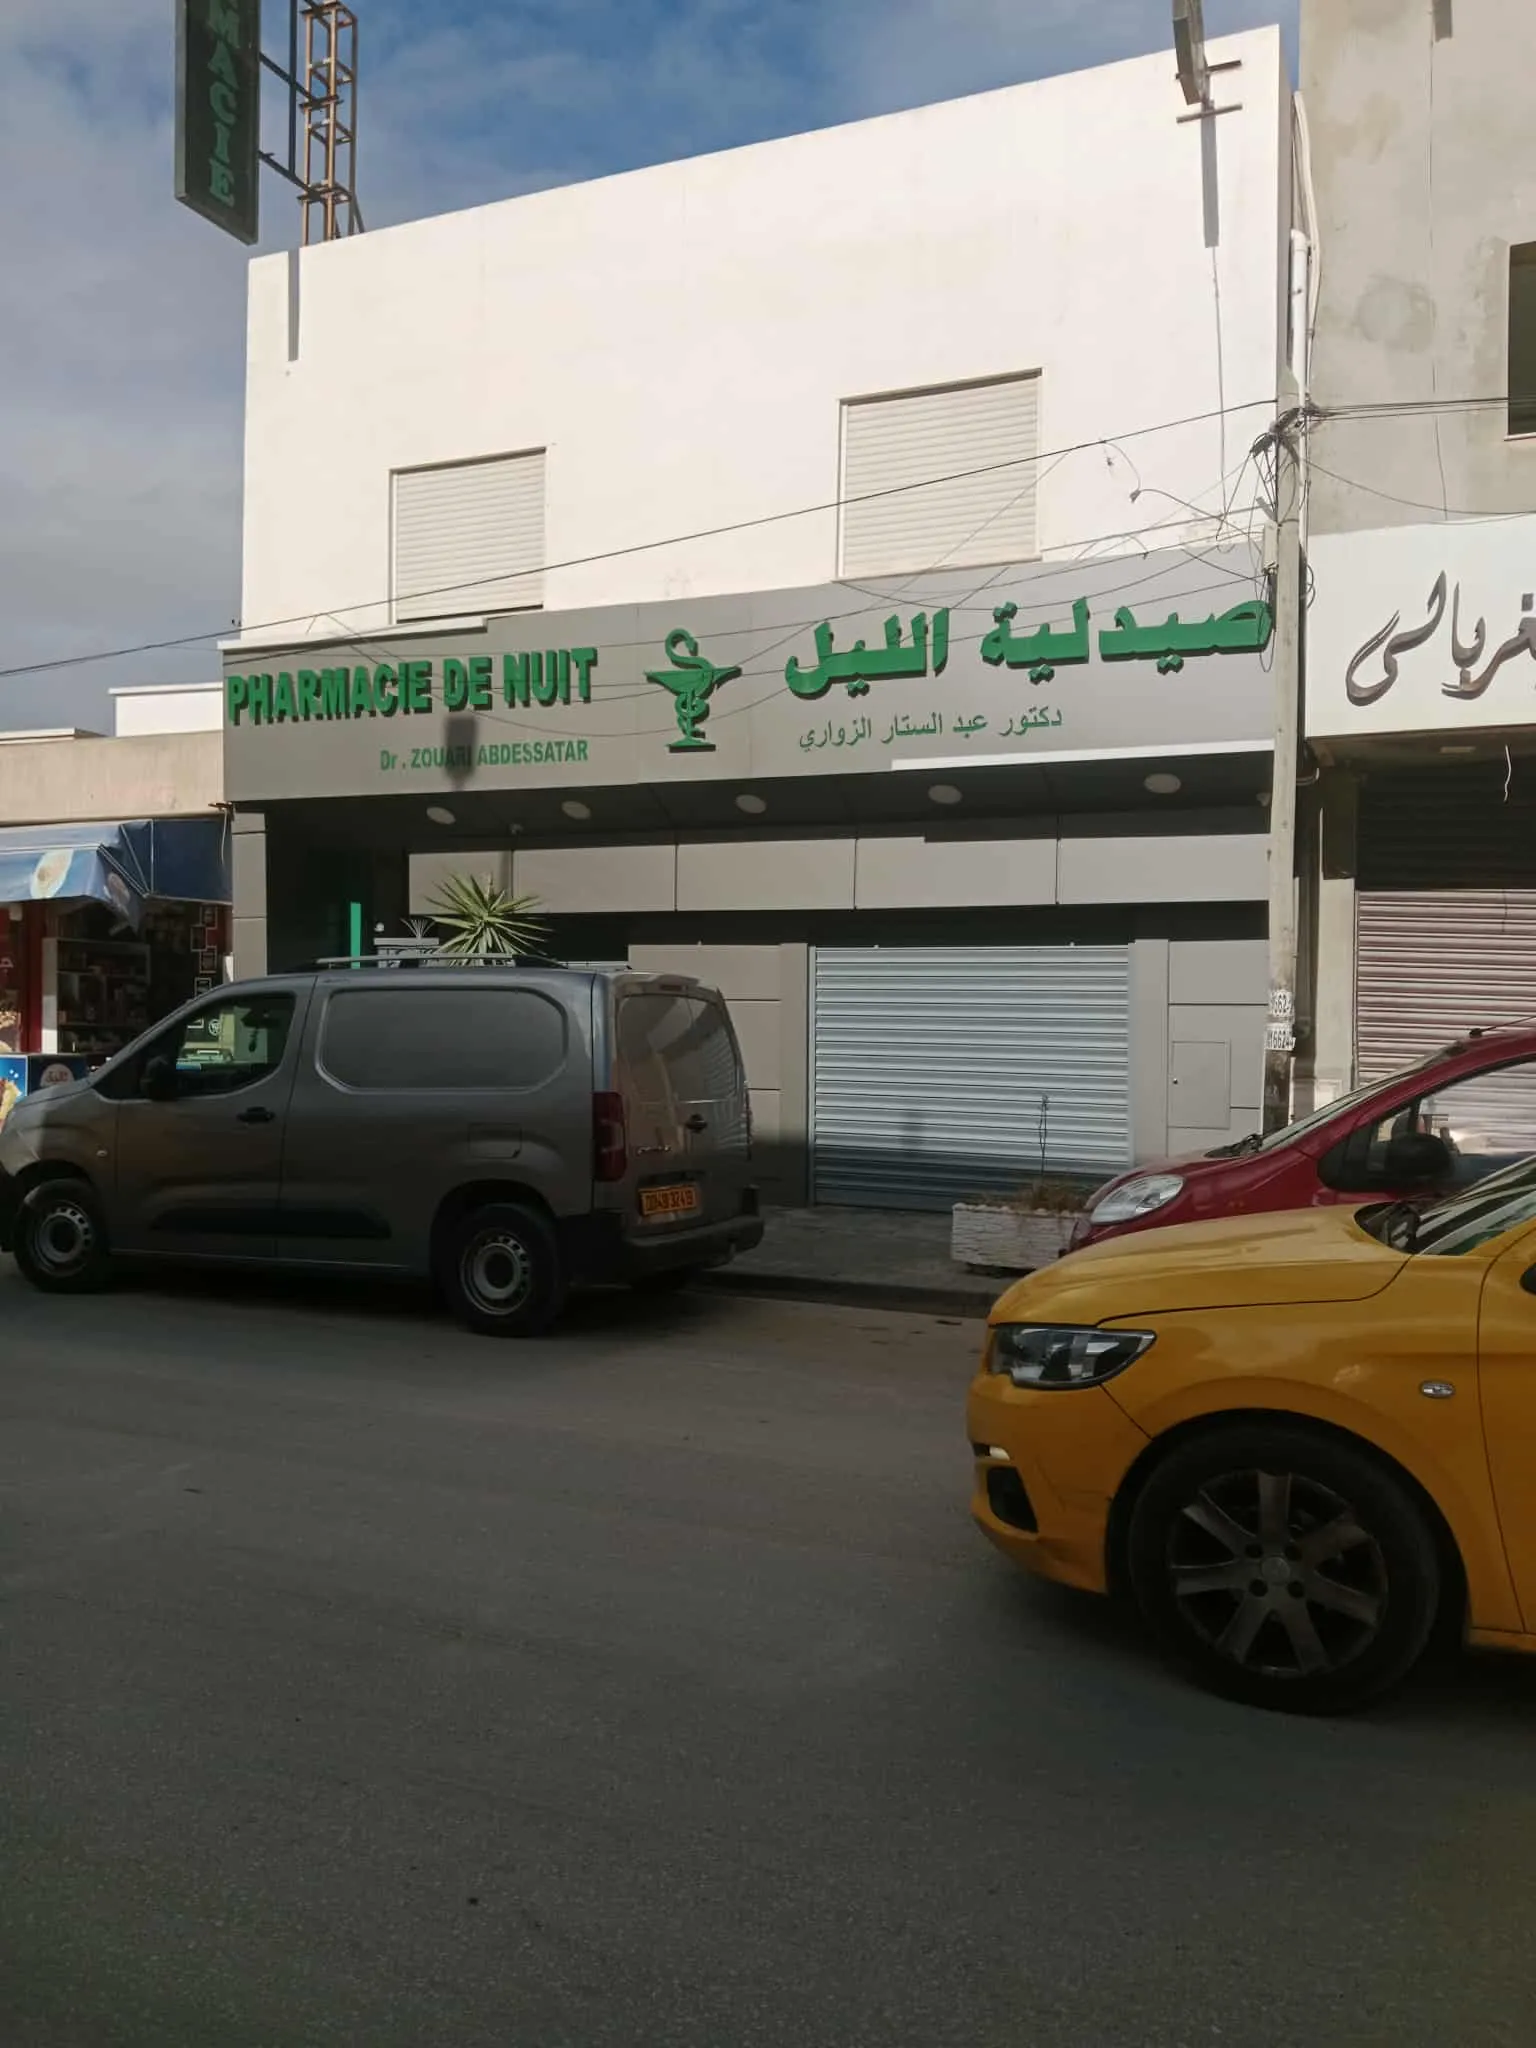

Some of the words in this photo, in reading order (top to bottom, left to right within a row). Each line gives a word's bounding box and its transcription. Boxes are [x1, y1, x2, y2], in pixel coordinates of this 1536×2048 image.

[206, 0, 240, 207] MACIE
[785, 607, 950, 698] الليل
[981, 597, 1274, 684] صيدلية
[228, 661, 433, 726] PHARMACIE
[443, 656, 493, 712] DE
[503, 647, 598, 709] NUIT
[799, 716, 872, 752] الزواري
[881, 711, 942, 744] الستار
[953, 713, 988, 739] عبد
[999, 706, 1062, 737] دكتور
[411, 747, 472, 769] ZOUARI
[477, 740, 589, 767] ABDESSATAR
